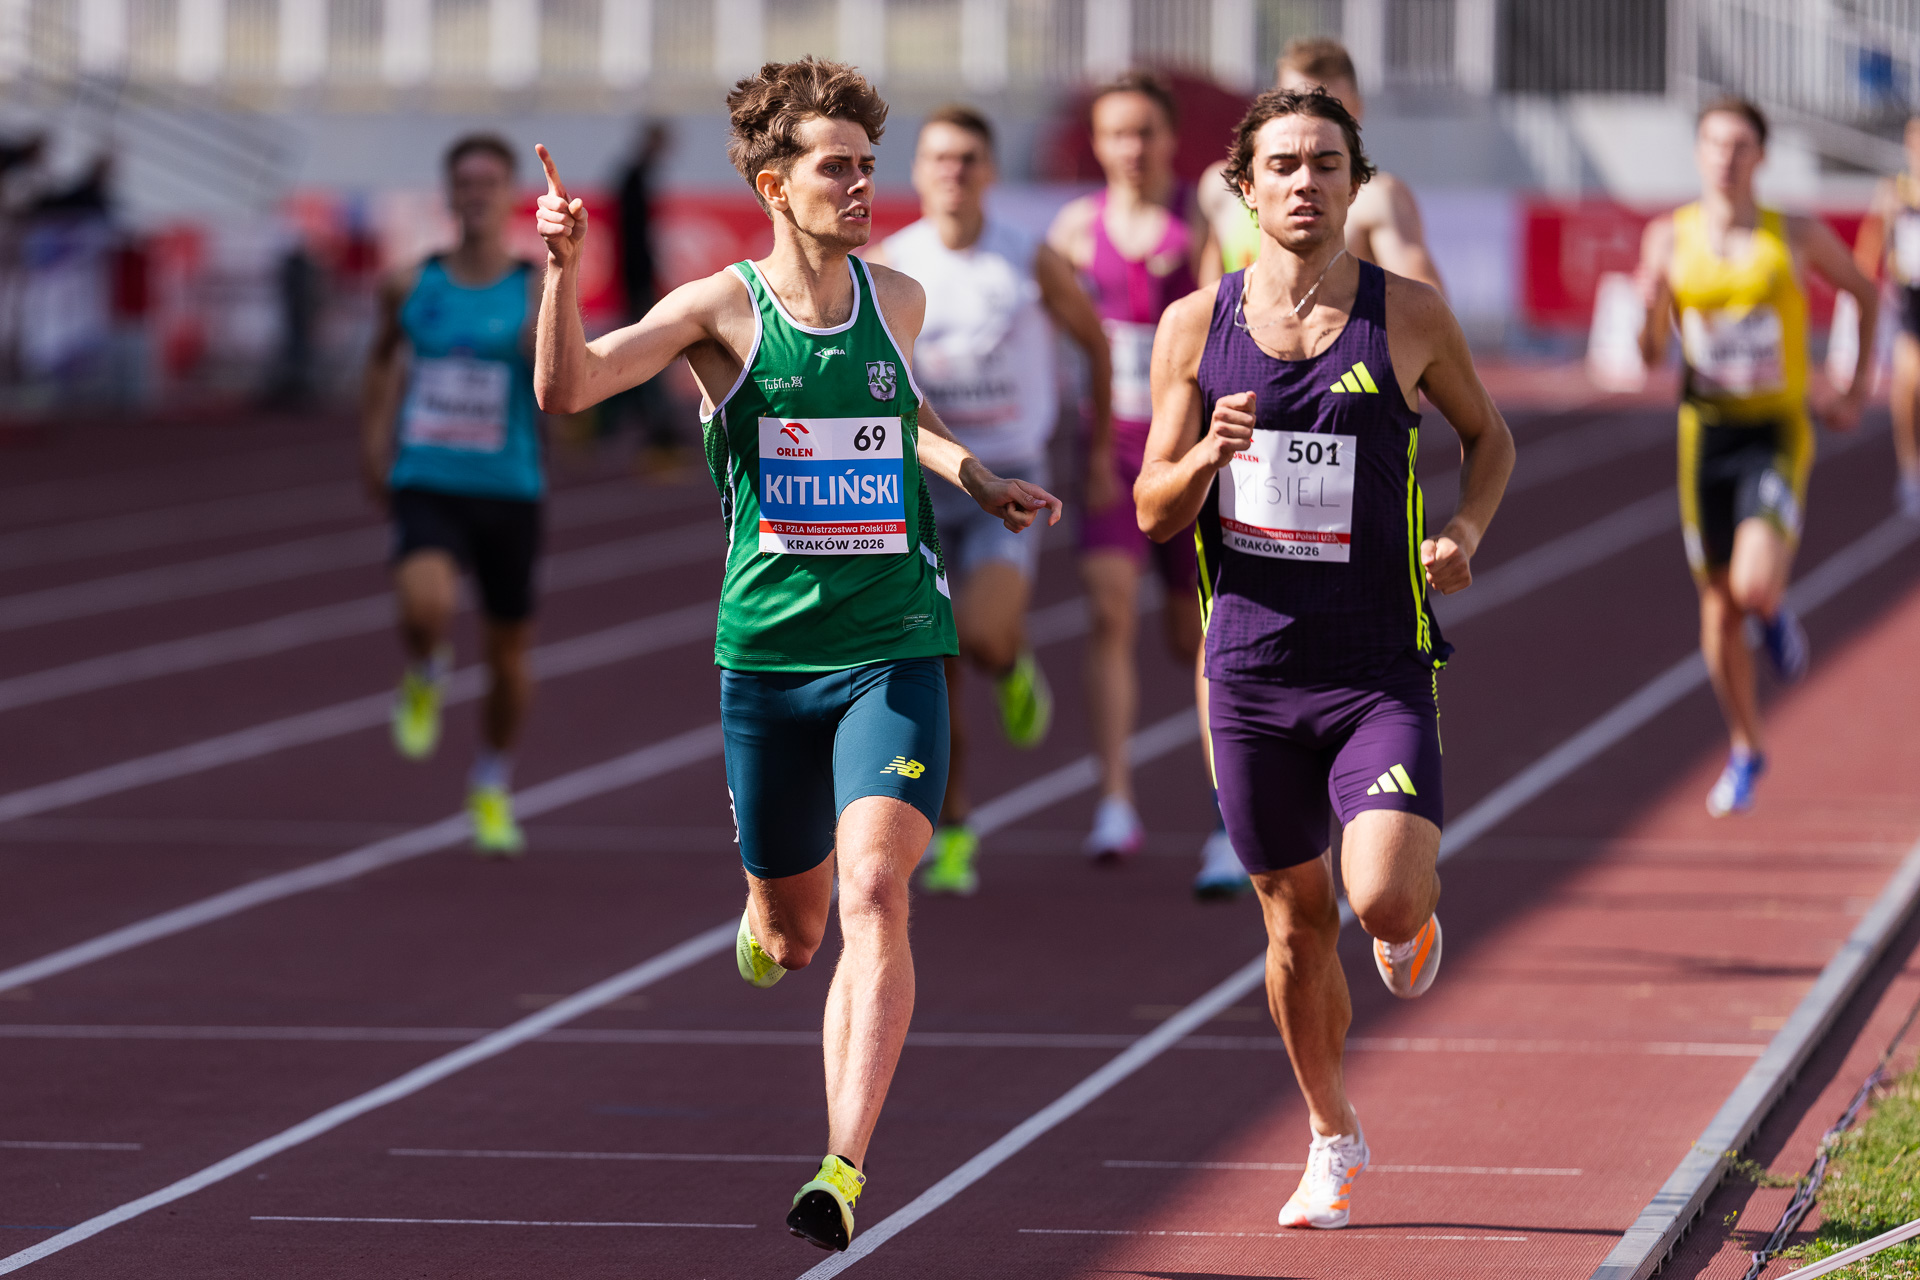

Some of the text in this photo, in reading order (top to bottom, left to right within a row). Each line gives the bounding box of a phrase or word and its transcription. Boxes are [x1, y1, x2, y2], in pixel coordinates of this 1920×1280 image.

[853, 425, 886, 452] 69
[776, 447, 813, 458] ORLEN
[1287, 439, 1340, 467] 501
[765, 468, 899, 506] KITLIŃSKI
[1237, 471, 1340, 508] KISIEL
[772, 524, 898, 534] 43. PZLA Mistrzostwa Polski U23
[1295, 532, 1320, 542] Polski
[787, 537, 885, 550] KRAKÓW 2026
[1234, 536, 1320, 557] KRAKÓW 2026
